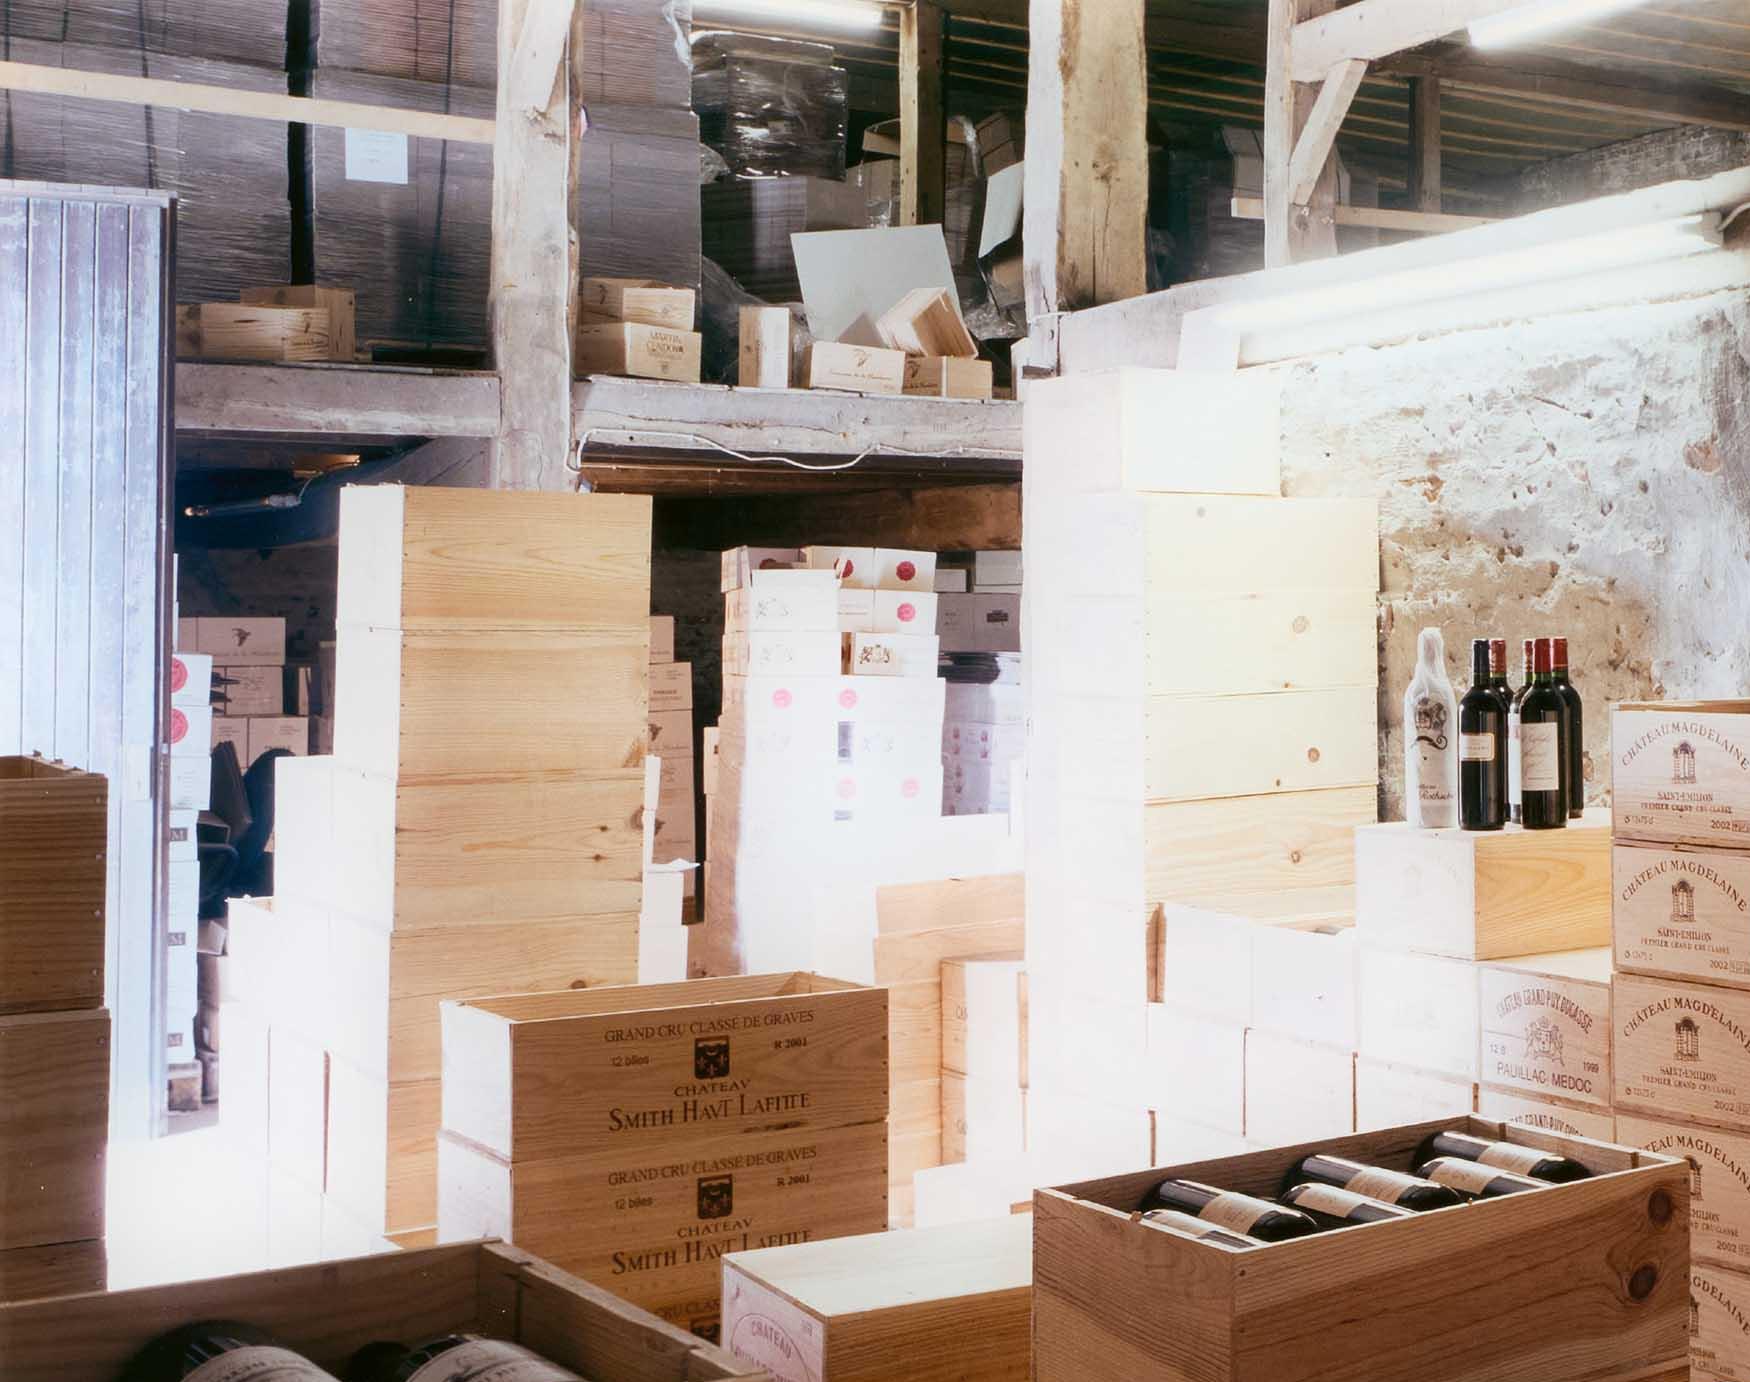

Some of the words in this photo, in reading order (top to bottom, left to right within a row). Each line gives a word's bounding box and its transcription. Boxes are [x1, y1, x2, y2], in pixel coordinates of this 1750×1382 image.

[1671, 721, 1749, 771] MAGDELAINE
[1711, 820, 1730, 830] 2002
[1670, 860, 1747, 912] MAGDELAINE
[1710, 960, 1728, 970] 2002
[604, 1027, 654, 1042] GRAND
[658, 1024, 687, 1037] CRU
[743, 1015, 761, 1027] DE
[763, 1010, 814, 1026] GRAVES
[1583, 1061, 1599, 1073] 1999
[674, 1080, 751, 1096] CHATEAV
[1552, 1074, 1592, 1093] MEDOC
[608, 1108, 674, 1131] SMITH
[683, 1097, 732, 1123] HAVT
[739, 1093, 810, 1116] LAFITTE
[1714, 1100, 1734, 1111] 2002
[746, 1153, 764, 1166] DE
[767, 1146, 816, 1163] GRAVES
[1717, 1240, 1737, 1252] 2002
[612, 1251, 676, 1274] SMITH
[685, 1239, 732, 1263] HAVT
[1692, 1276, 1750, 1336] GDELAINE
